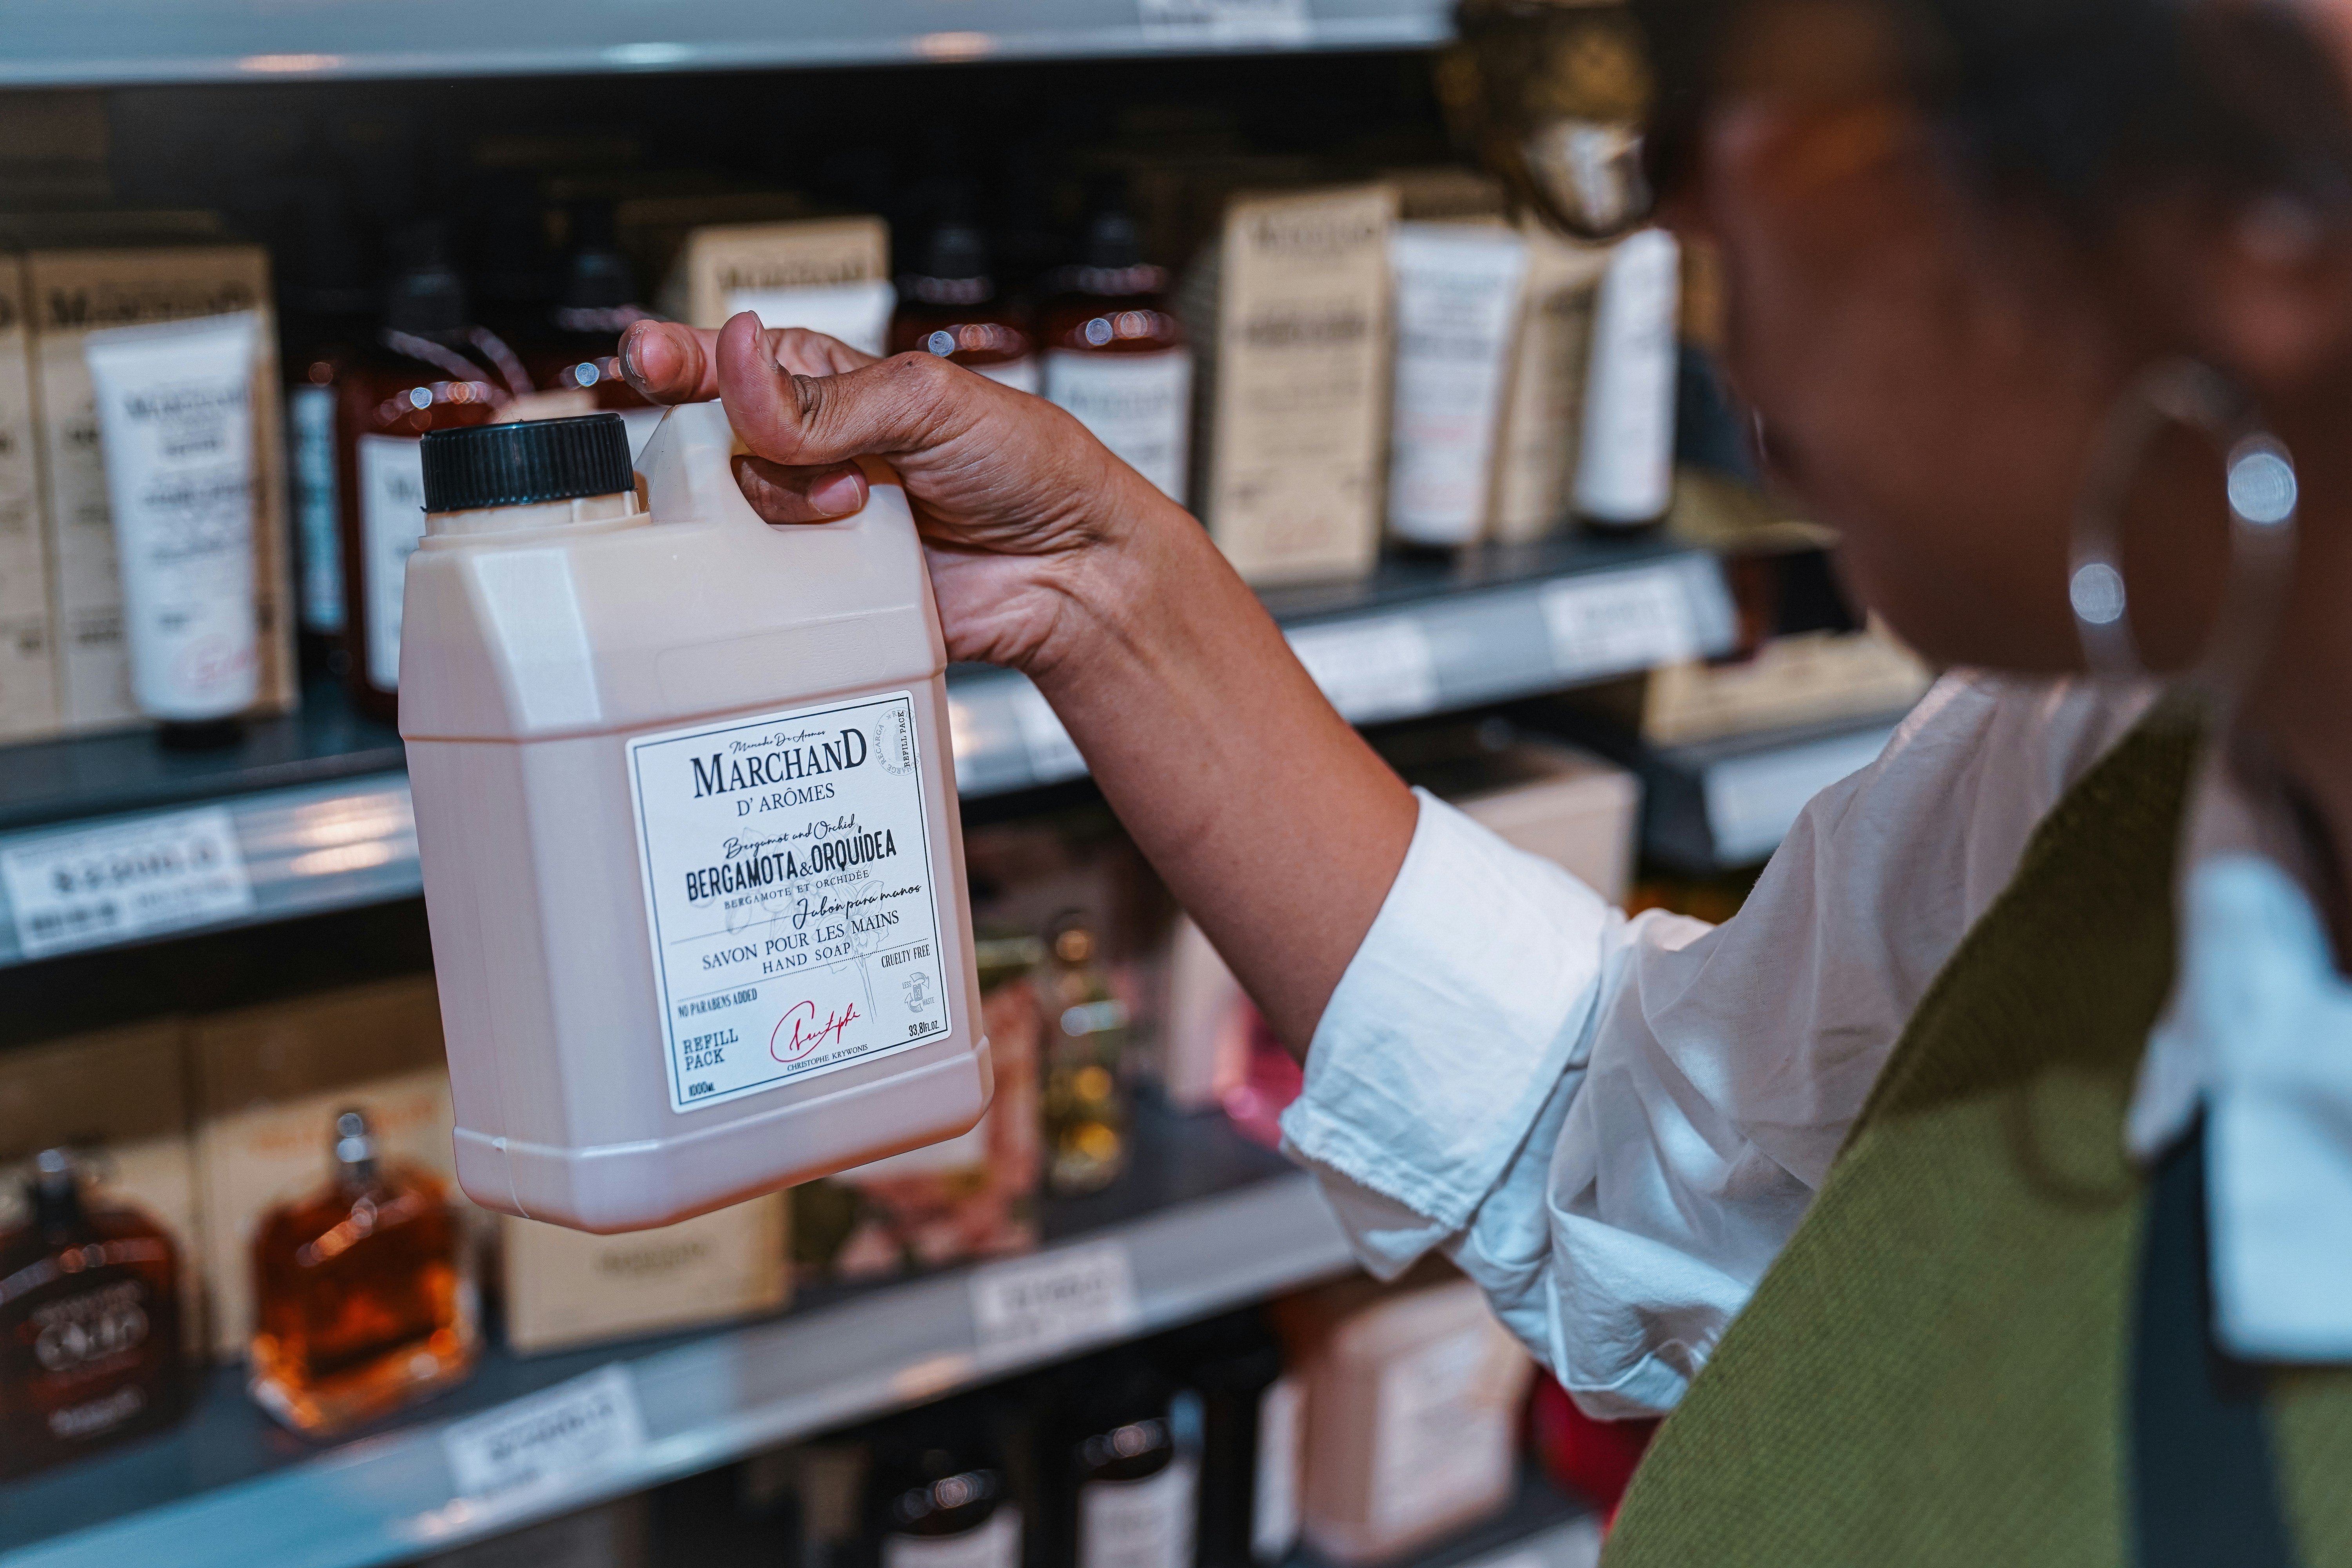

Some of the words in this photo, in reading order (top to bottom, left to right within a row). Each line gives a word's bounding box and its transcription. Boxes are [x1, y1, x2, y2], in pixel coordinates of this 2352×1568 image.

[775, 733, 792, 746] De
[875, 724, 886, 765] RECARGA
[901, 736, 910, 767] REFILL
[690, 728, 867, 799] MARCHAND
[759, 783, 835, 812] ARÔMES
[723, 833, 789, 859] Bergamot
[792, 824, 812, 839] and
[814, 814, 855, 840] Orchid
[724, 887, 791, 909] BERGAMOTE
[797, 883, 810, 893] ET
[816, 869, 869, 888] ORCHIDÉE
[846, 896, 878, 919] para
[880, 885, 922, 901] manos
[702, 943, 757, 970] SAVON
[766, 933, 809, 955] POUR
[816, 924, 844, 942] LES
[851, 910, 899, 934] MAINS
[881, 949, 911, 967] CRUELTY
[913, 944, 930, 960] FREE
[763, 953, 807, 974] HAND
[815, 942, 851, 960] SOAP
[902, 981, 911, 989] LESS
[678, 1004, 689, 1018] NO
[690, 994, 731, 1016] PARABENS
[733, 987, 757, 1004] ADDED
[922, 996, 935, 1006] WASTE
[683, 1028, 739, 1054] REFILL
[685, 1047, 725, 1071] PACK
[787, 1054, 829, 1071] CHRISTOPHE
[832, 1044, 868, 1059] KRYWONIS
